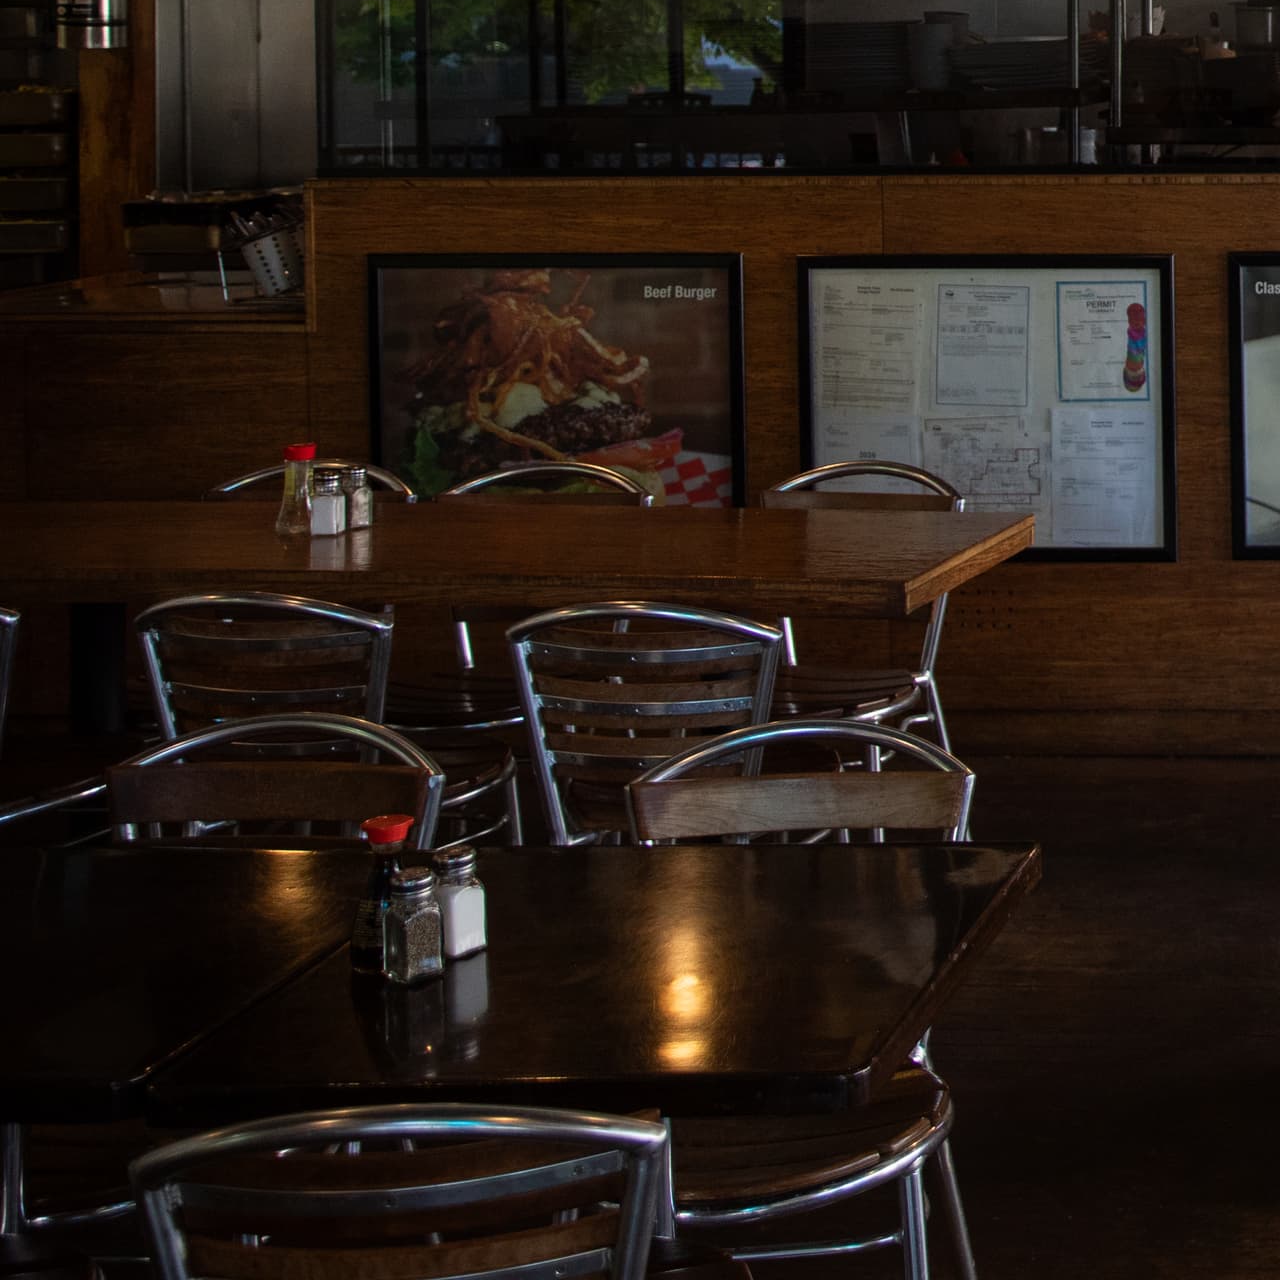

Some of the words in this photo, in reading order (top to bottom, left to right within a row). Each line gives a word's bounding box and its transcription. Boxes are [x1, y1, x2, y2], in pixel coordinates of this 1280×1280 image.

[644, 285, 672, 298] Beef
[675, 285, 717, 301] Burger
[1086, 301, 1116, 309] PERMIT
